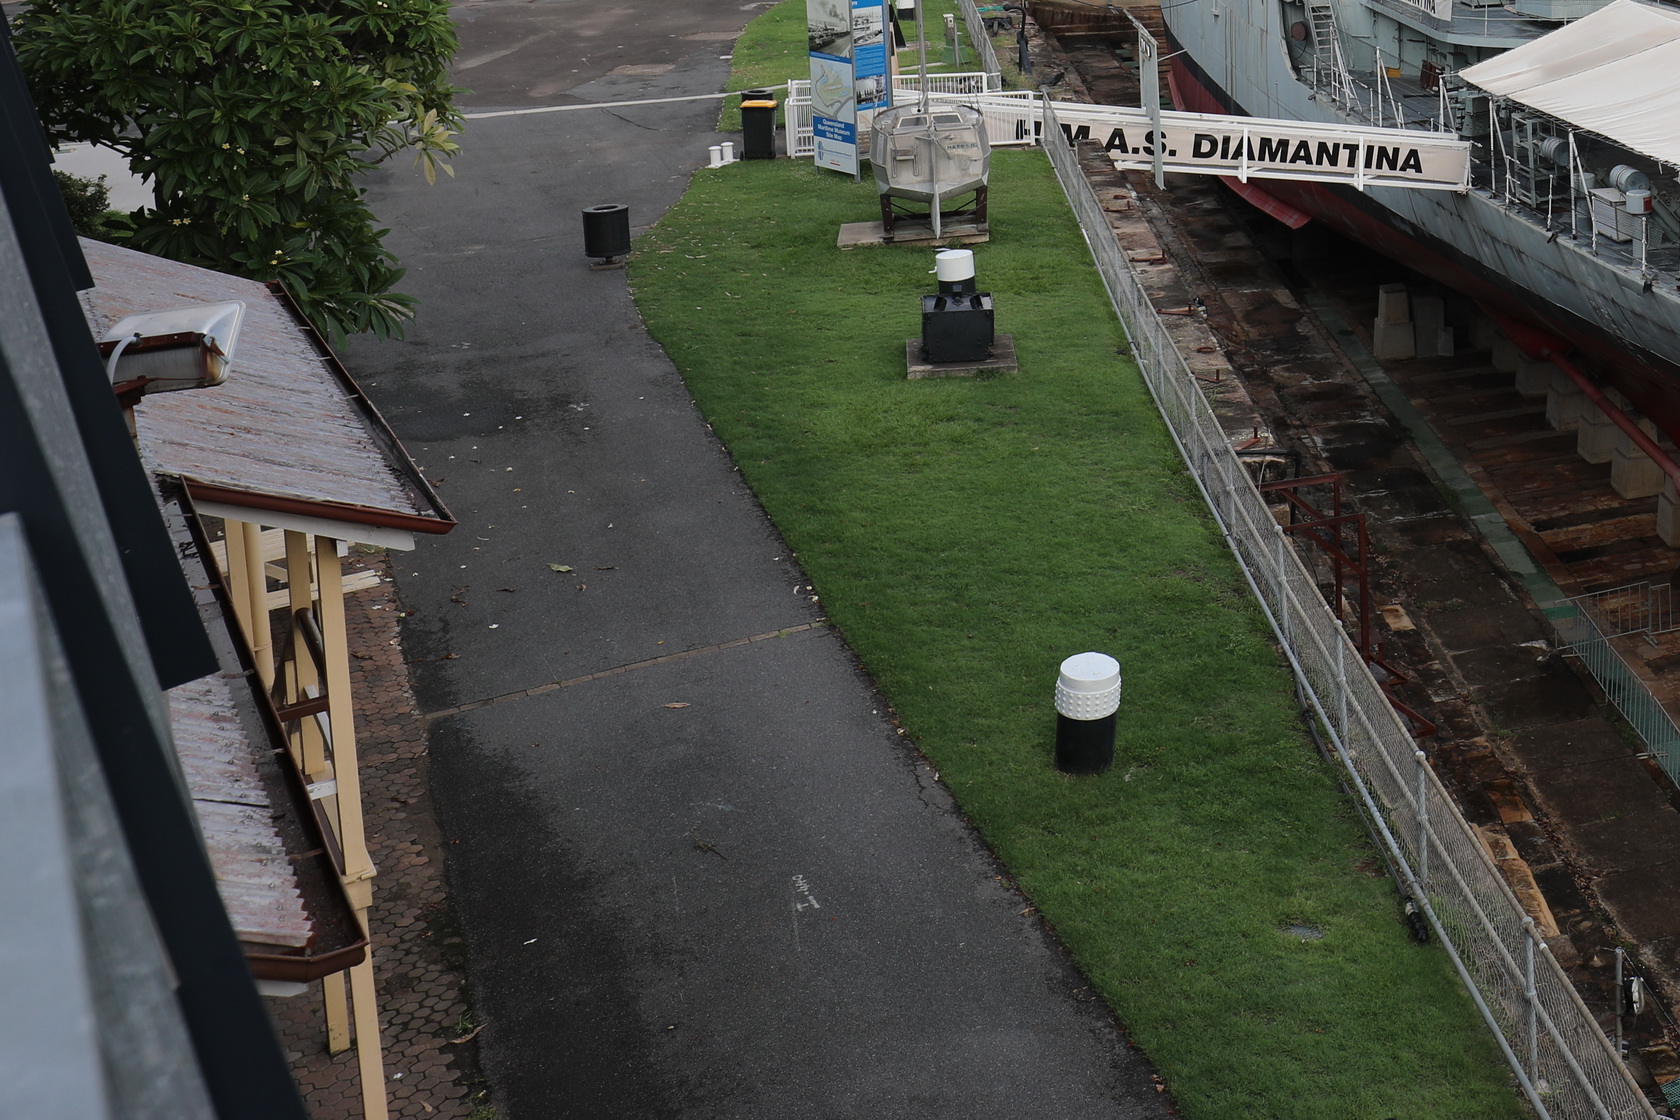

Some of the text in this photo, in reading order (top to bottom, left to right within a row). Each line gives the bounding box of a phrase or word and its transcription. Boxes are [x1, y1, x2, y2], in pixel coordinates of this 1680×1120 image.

[822, 119, 844, 129] Queensland
[834, 132, 842, 141] Map
[1192, 133, 1423, 174] DIAMANTINA
